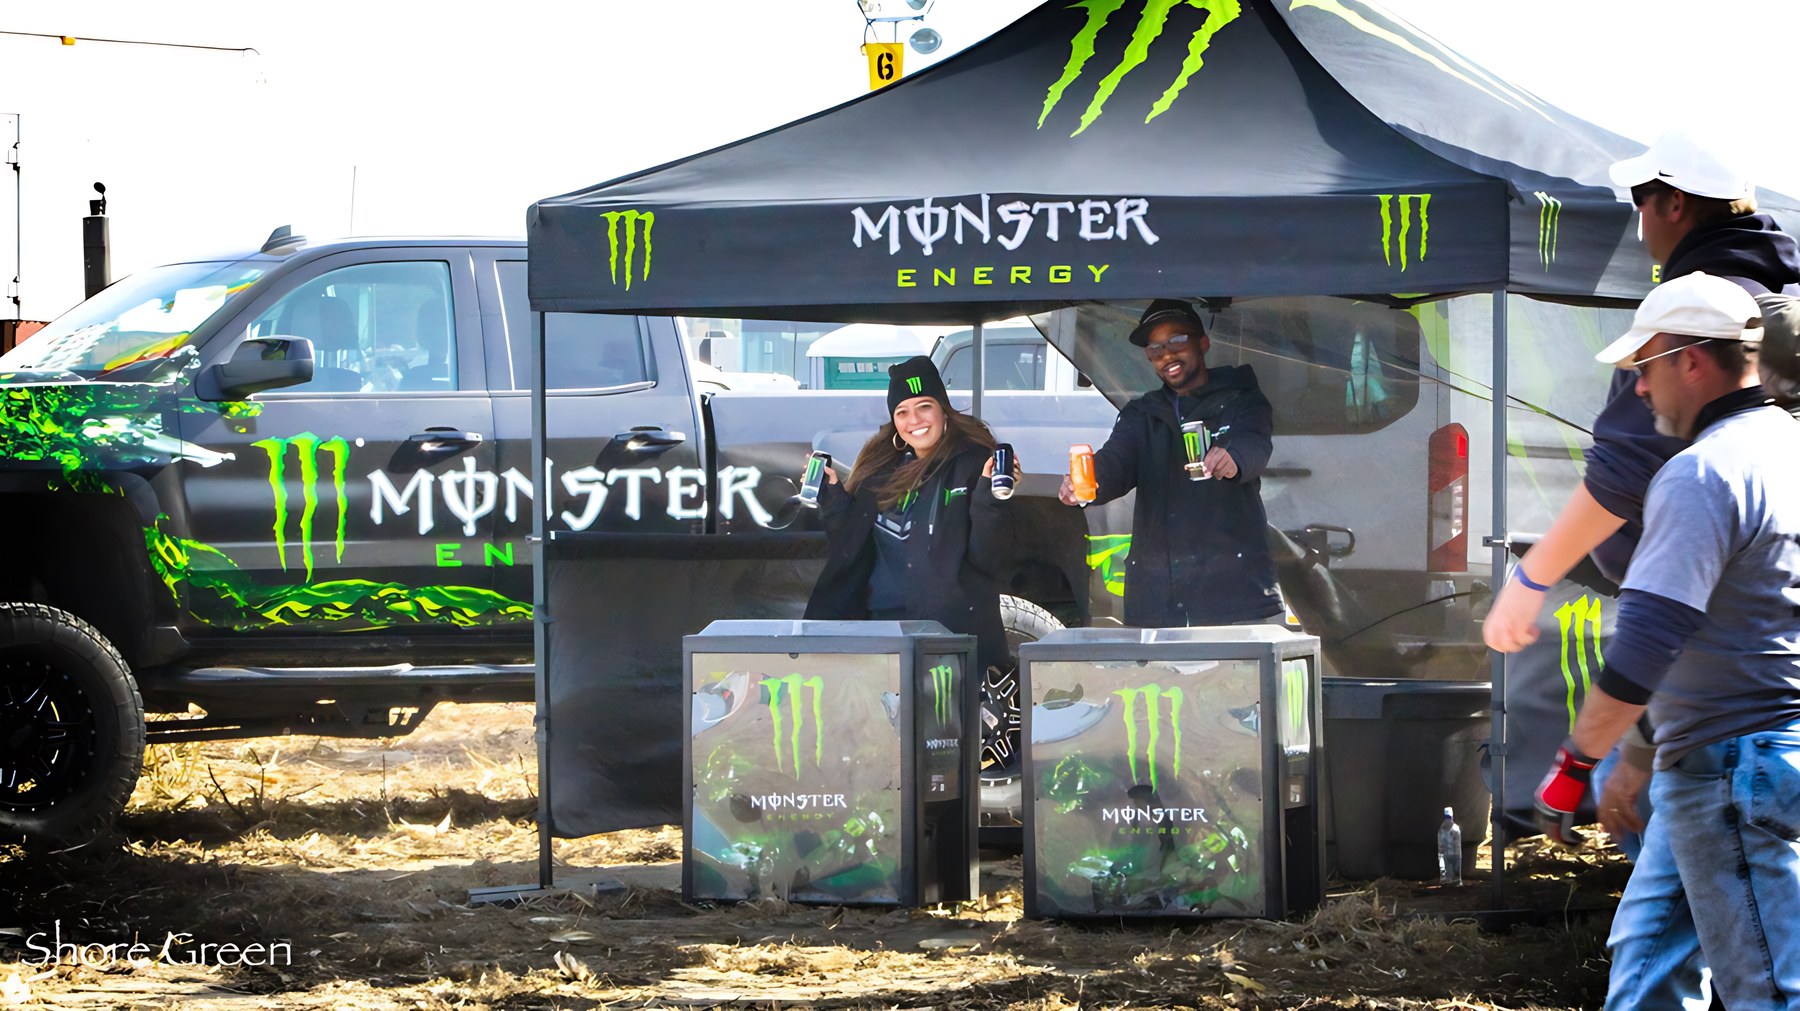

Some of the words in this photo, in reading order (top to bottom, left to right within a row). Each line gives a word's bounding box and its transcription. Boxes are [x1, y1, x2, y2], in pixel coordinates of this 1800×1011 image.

[877, 52, 894, 80] 6
[851, 193, 1160, 256] MONSTER
[897, 264, 1110, 287] ENERGY
[367, 456, 773, 537] MONSTER
[750, 792, 848, 811] MONSTER
[1102, 804, 1209, 825] MONSTER
